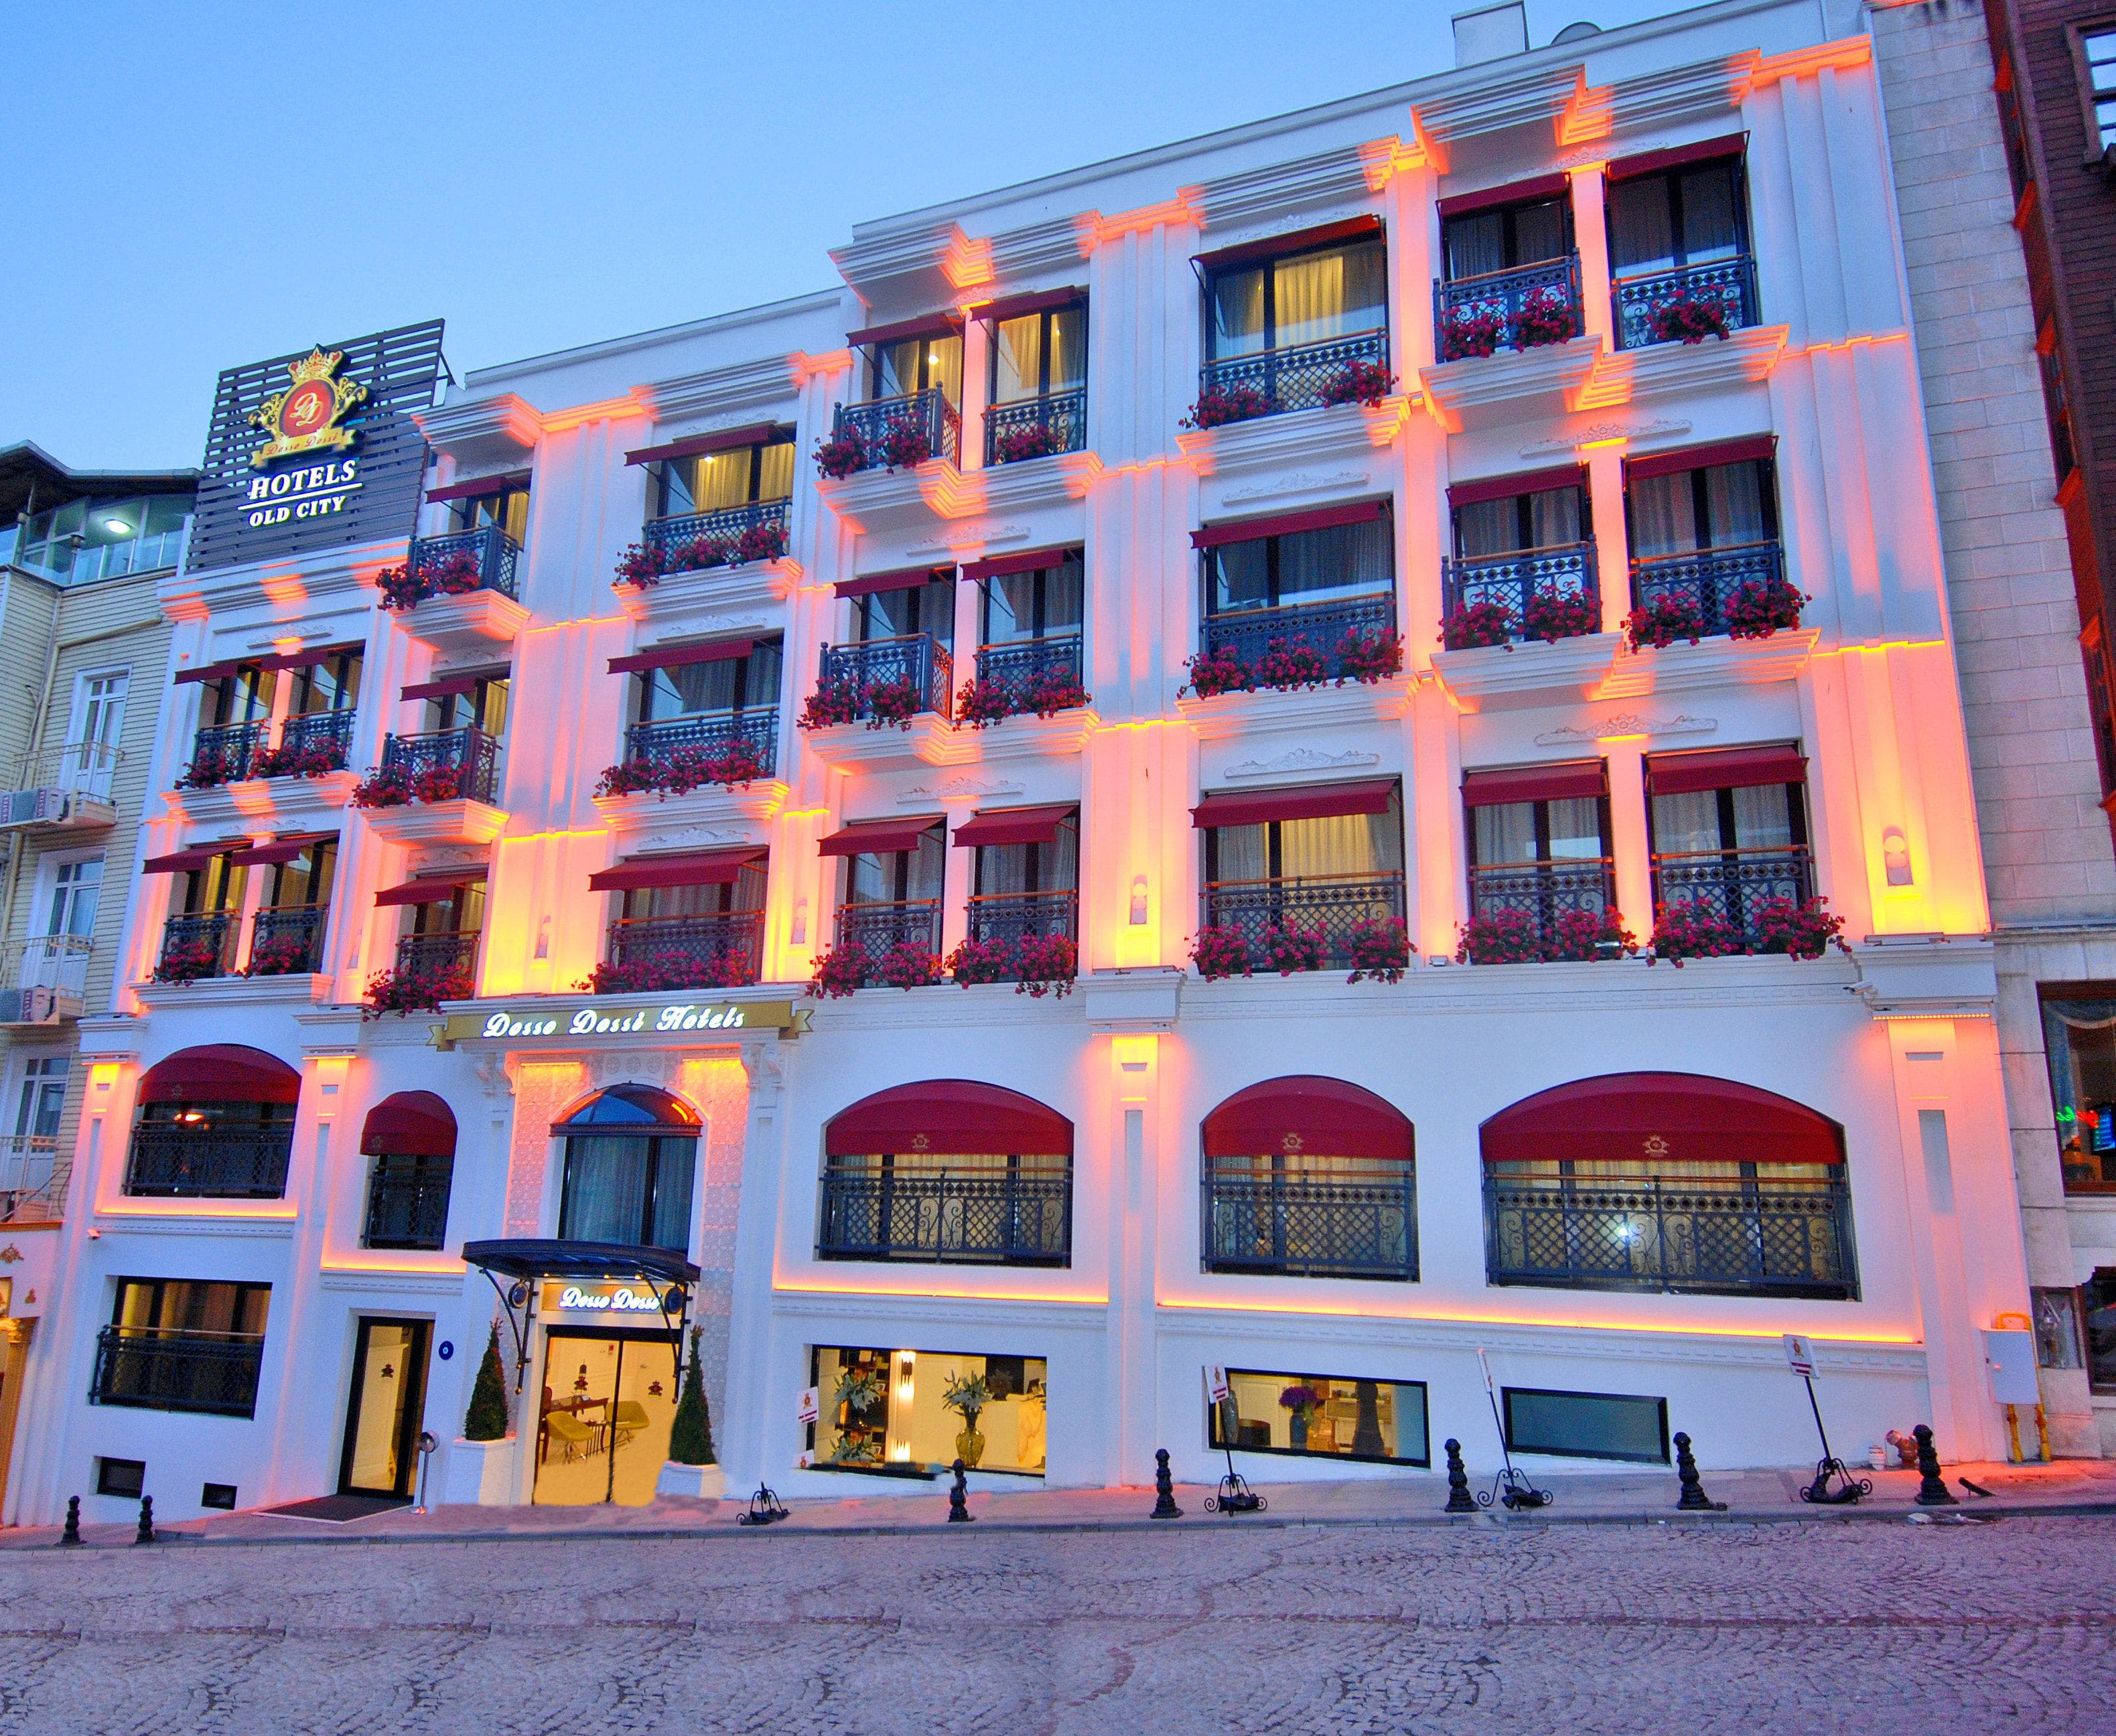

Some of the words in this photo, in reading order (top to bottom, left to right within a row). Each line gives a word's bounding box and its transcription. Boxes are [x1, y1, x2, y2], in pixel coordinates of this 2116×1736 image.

[249, 459, 356, 500] HOTELS
[249, 506, 291, 527] OLD
[297, 496, 347, 518] CITY
[482, 1011, 557, 1037] Dosso
[569, 1008, 644, 1035] Dossi
[656, 1004, 746, 1031] Hotels
[559, 1287, 610, 1309] Dosso
